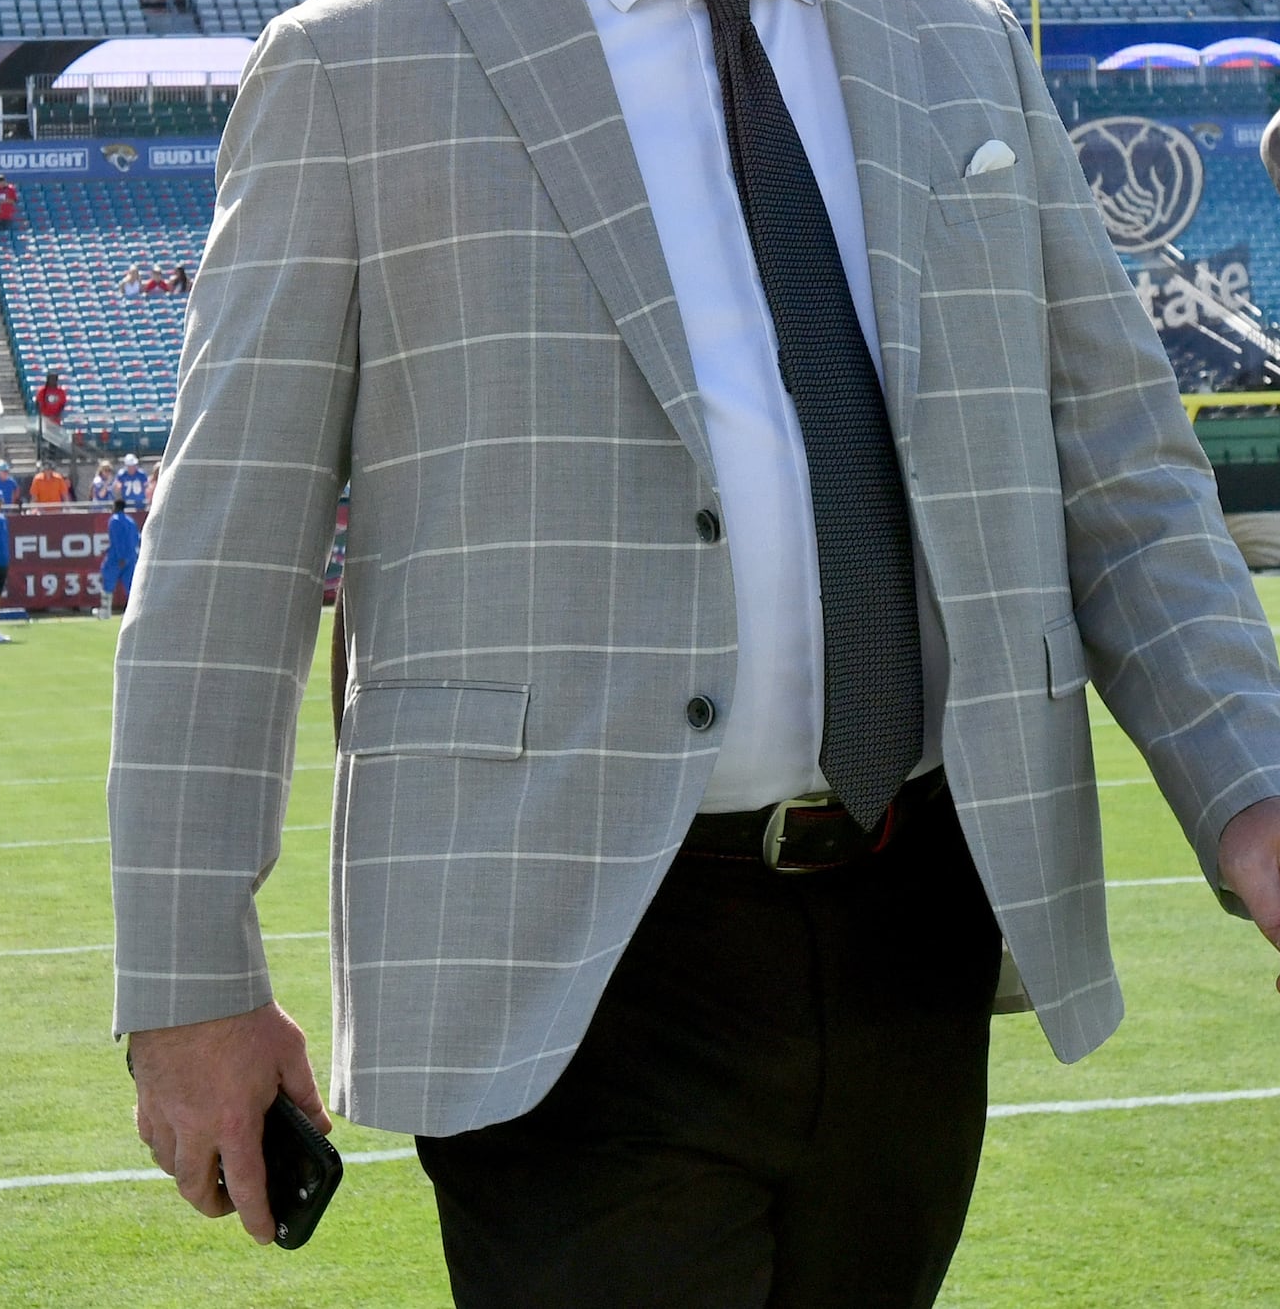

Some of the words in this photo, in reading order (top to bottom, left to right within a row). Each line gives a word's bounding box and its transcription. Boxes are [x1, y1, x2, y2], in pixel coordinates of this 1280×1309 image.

[29, 152, 85, 168] LIGHT
[153, 150, 194, 165] BUD
[195, 149, 219, 164] LIG
[1135, 260, 1252, 332] tate
[14, 533, 111, 560] FLOR
[25, 572, 104, 598] 1933
